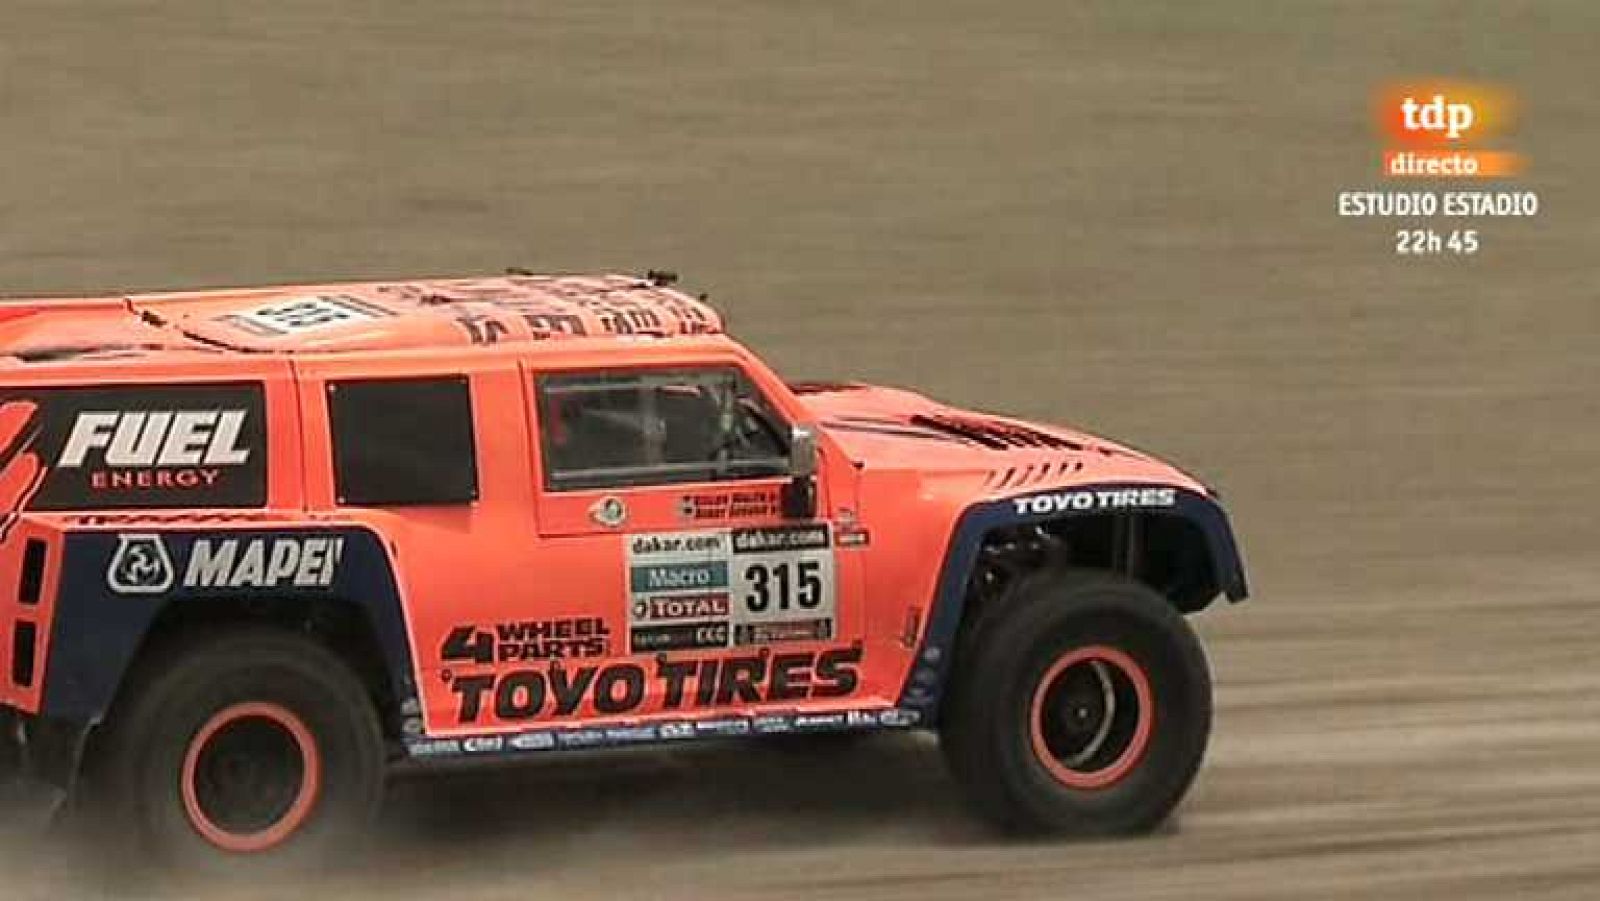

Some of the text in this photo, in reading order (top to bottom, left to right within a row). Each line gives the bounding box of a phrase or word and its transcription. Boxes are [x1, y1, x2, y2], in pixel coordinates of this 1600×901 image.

[58, 409, 250, 467] FUEL
[91, 469, 221, 489] ENERGY
[1014, 488, 1176, 514] TOYO TIRES
[633, 535, 721, 553] dakar.com
[735, 528, 827, 549] dakar.com
[184, 537, 344, 587] MAPEI
[650, 566, 711, 588] Macro
[745, 562, 822, 612] 315
[654, 599, 728, 619] TOTAL
[441, 624, 495, 663] 4
[498, 616, 610, 641] WHEEL
[499, 638, 607, 662] PARTS
[451, 641, 863, 723] TOYO TIRES
